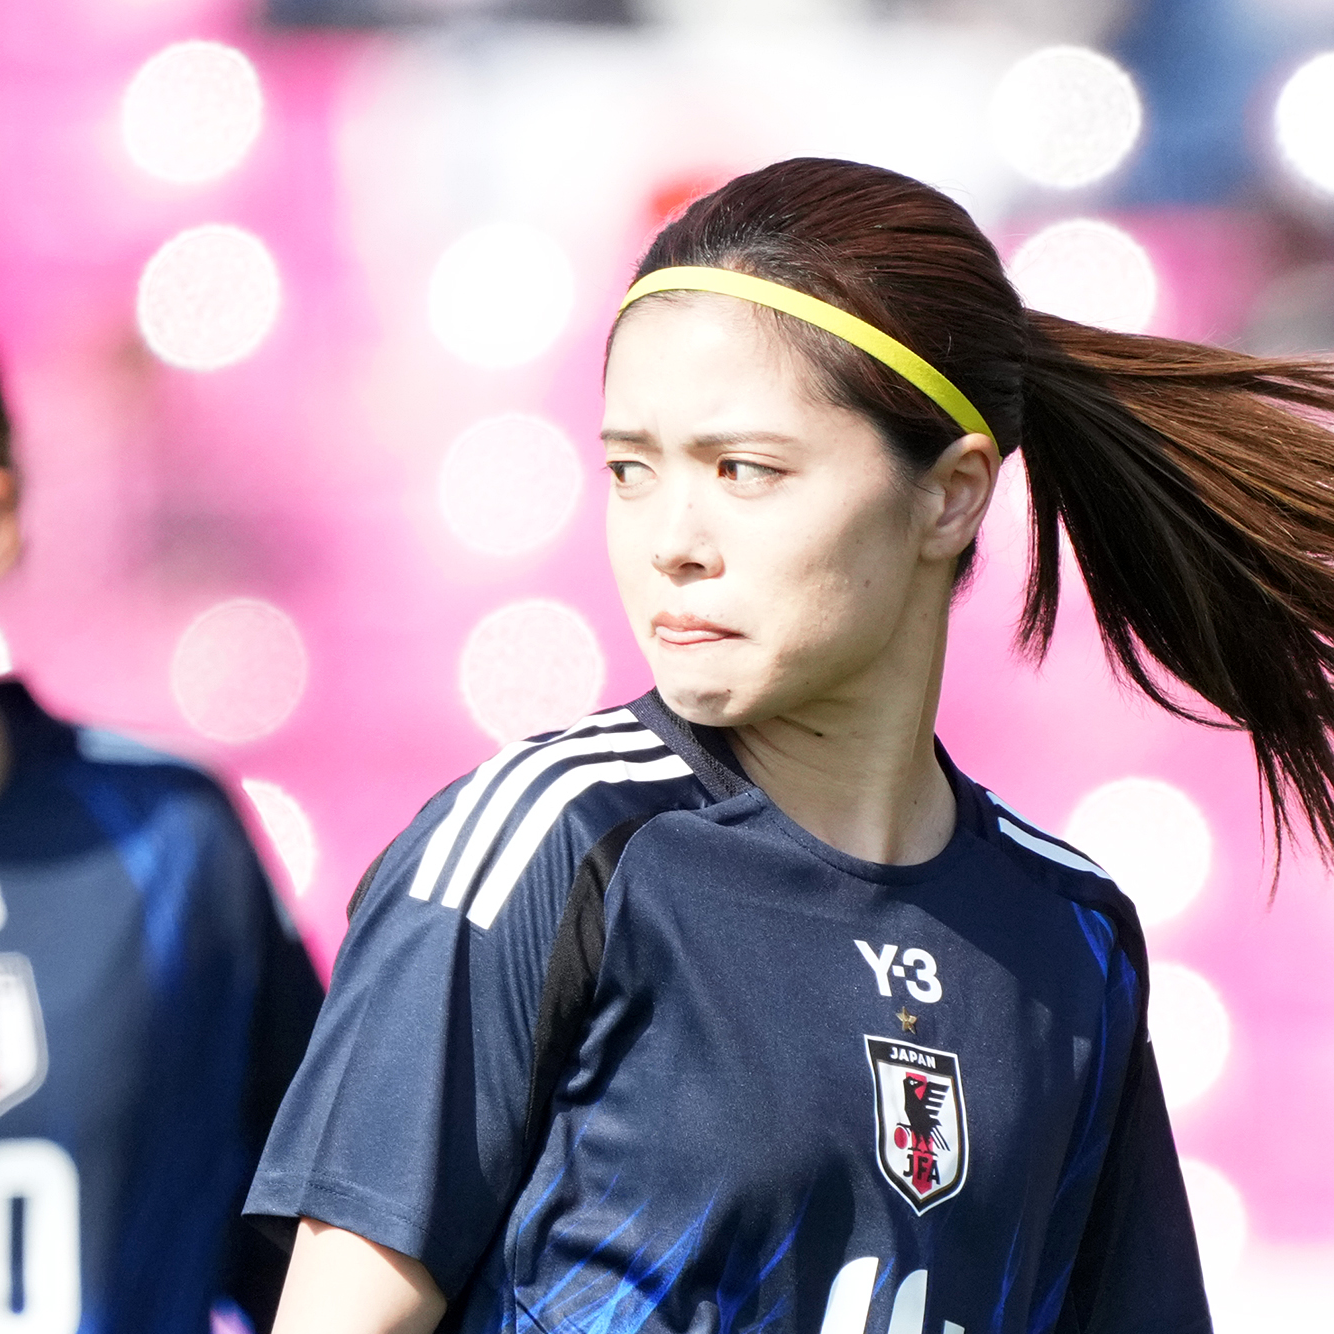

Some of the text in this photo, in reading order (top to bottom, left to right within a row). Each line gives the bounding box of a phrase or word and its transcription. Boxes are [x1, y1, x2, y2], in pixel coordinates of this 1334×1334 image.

[854, 939, 943, 1003] Y-3
[889, 1045, 937, 1069] JAPAN
[902, 1153, 941, 1186] JFA
